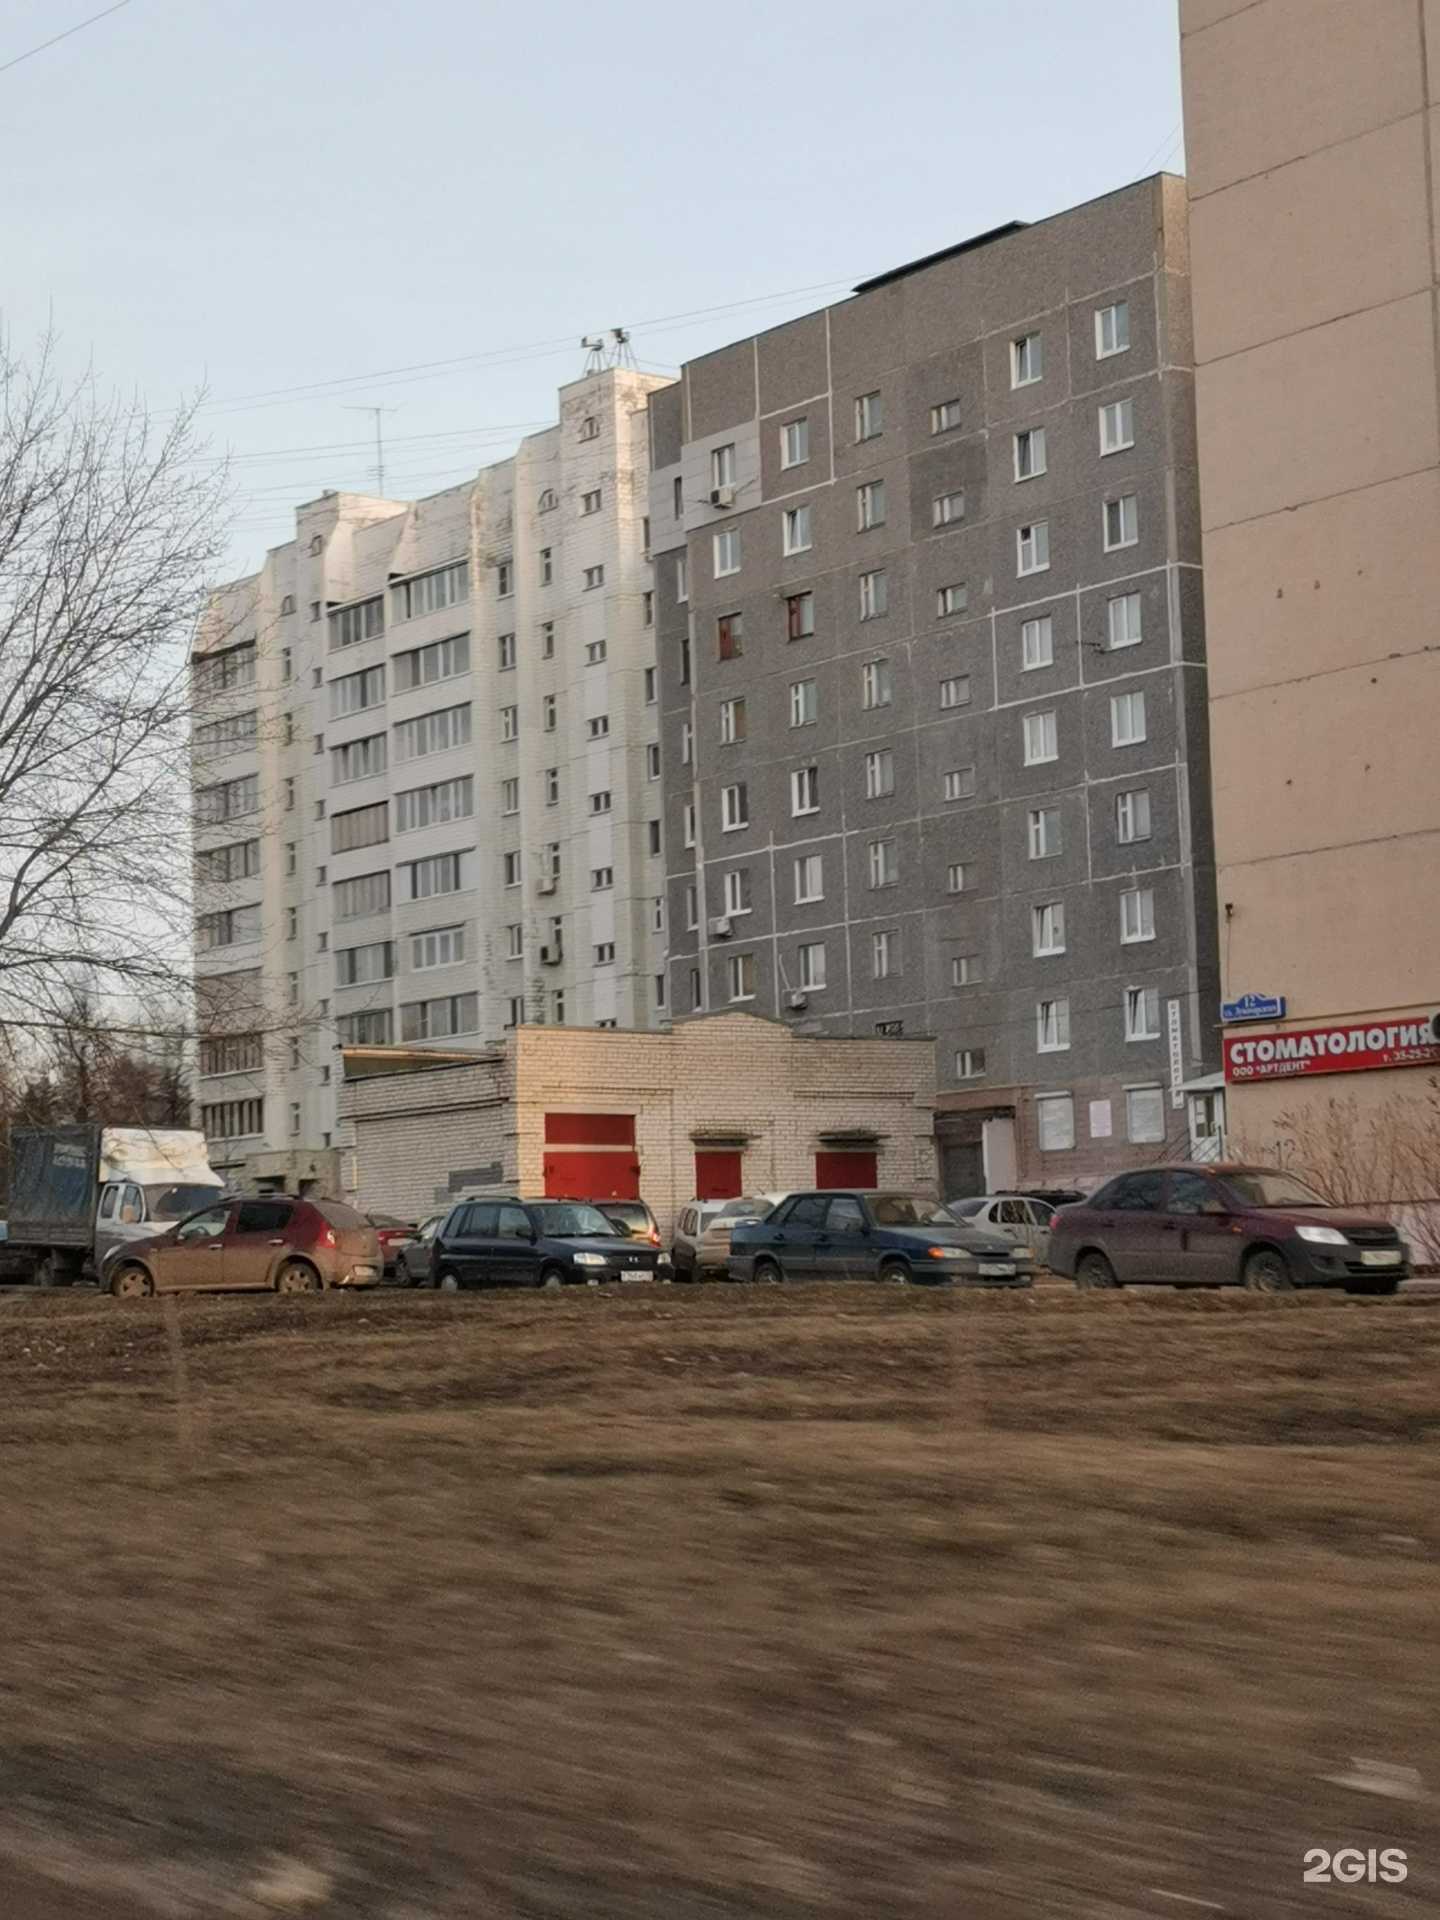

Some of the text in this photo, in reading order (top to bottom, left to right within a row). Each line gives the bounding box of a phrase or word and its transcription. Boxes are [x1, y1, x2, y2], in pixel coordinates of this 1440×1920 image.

[1244, 996, 1257, 1008] 12
[1170, 1003, 1182, 1097] СТОМАТОЛОГЯ
[1230, 1024, 1434, 1065] СТОМАТОЛОГИЯ
[1232, 1065, 1254, 1077] ООО
